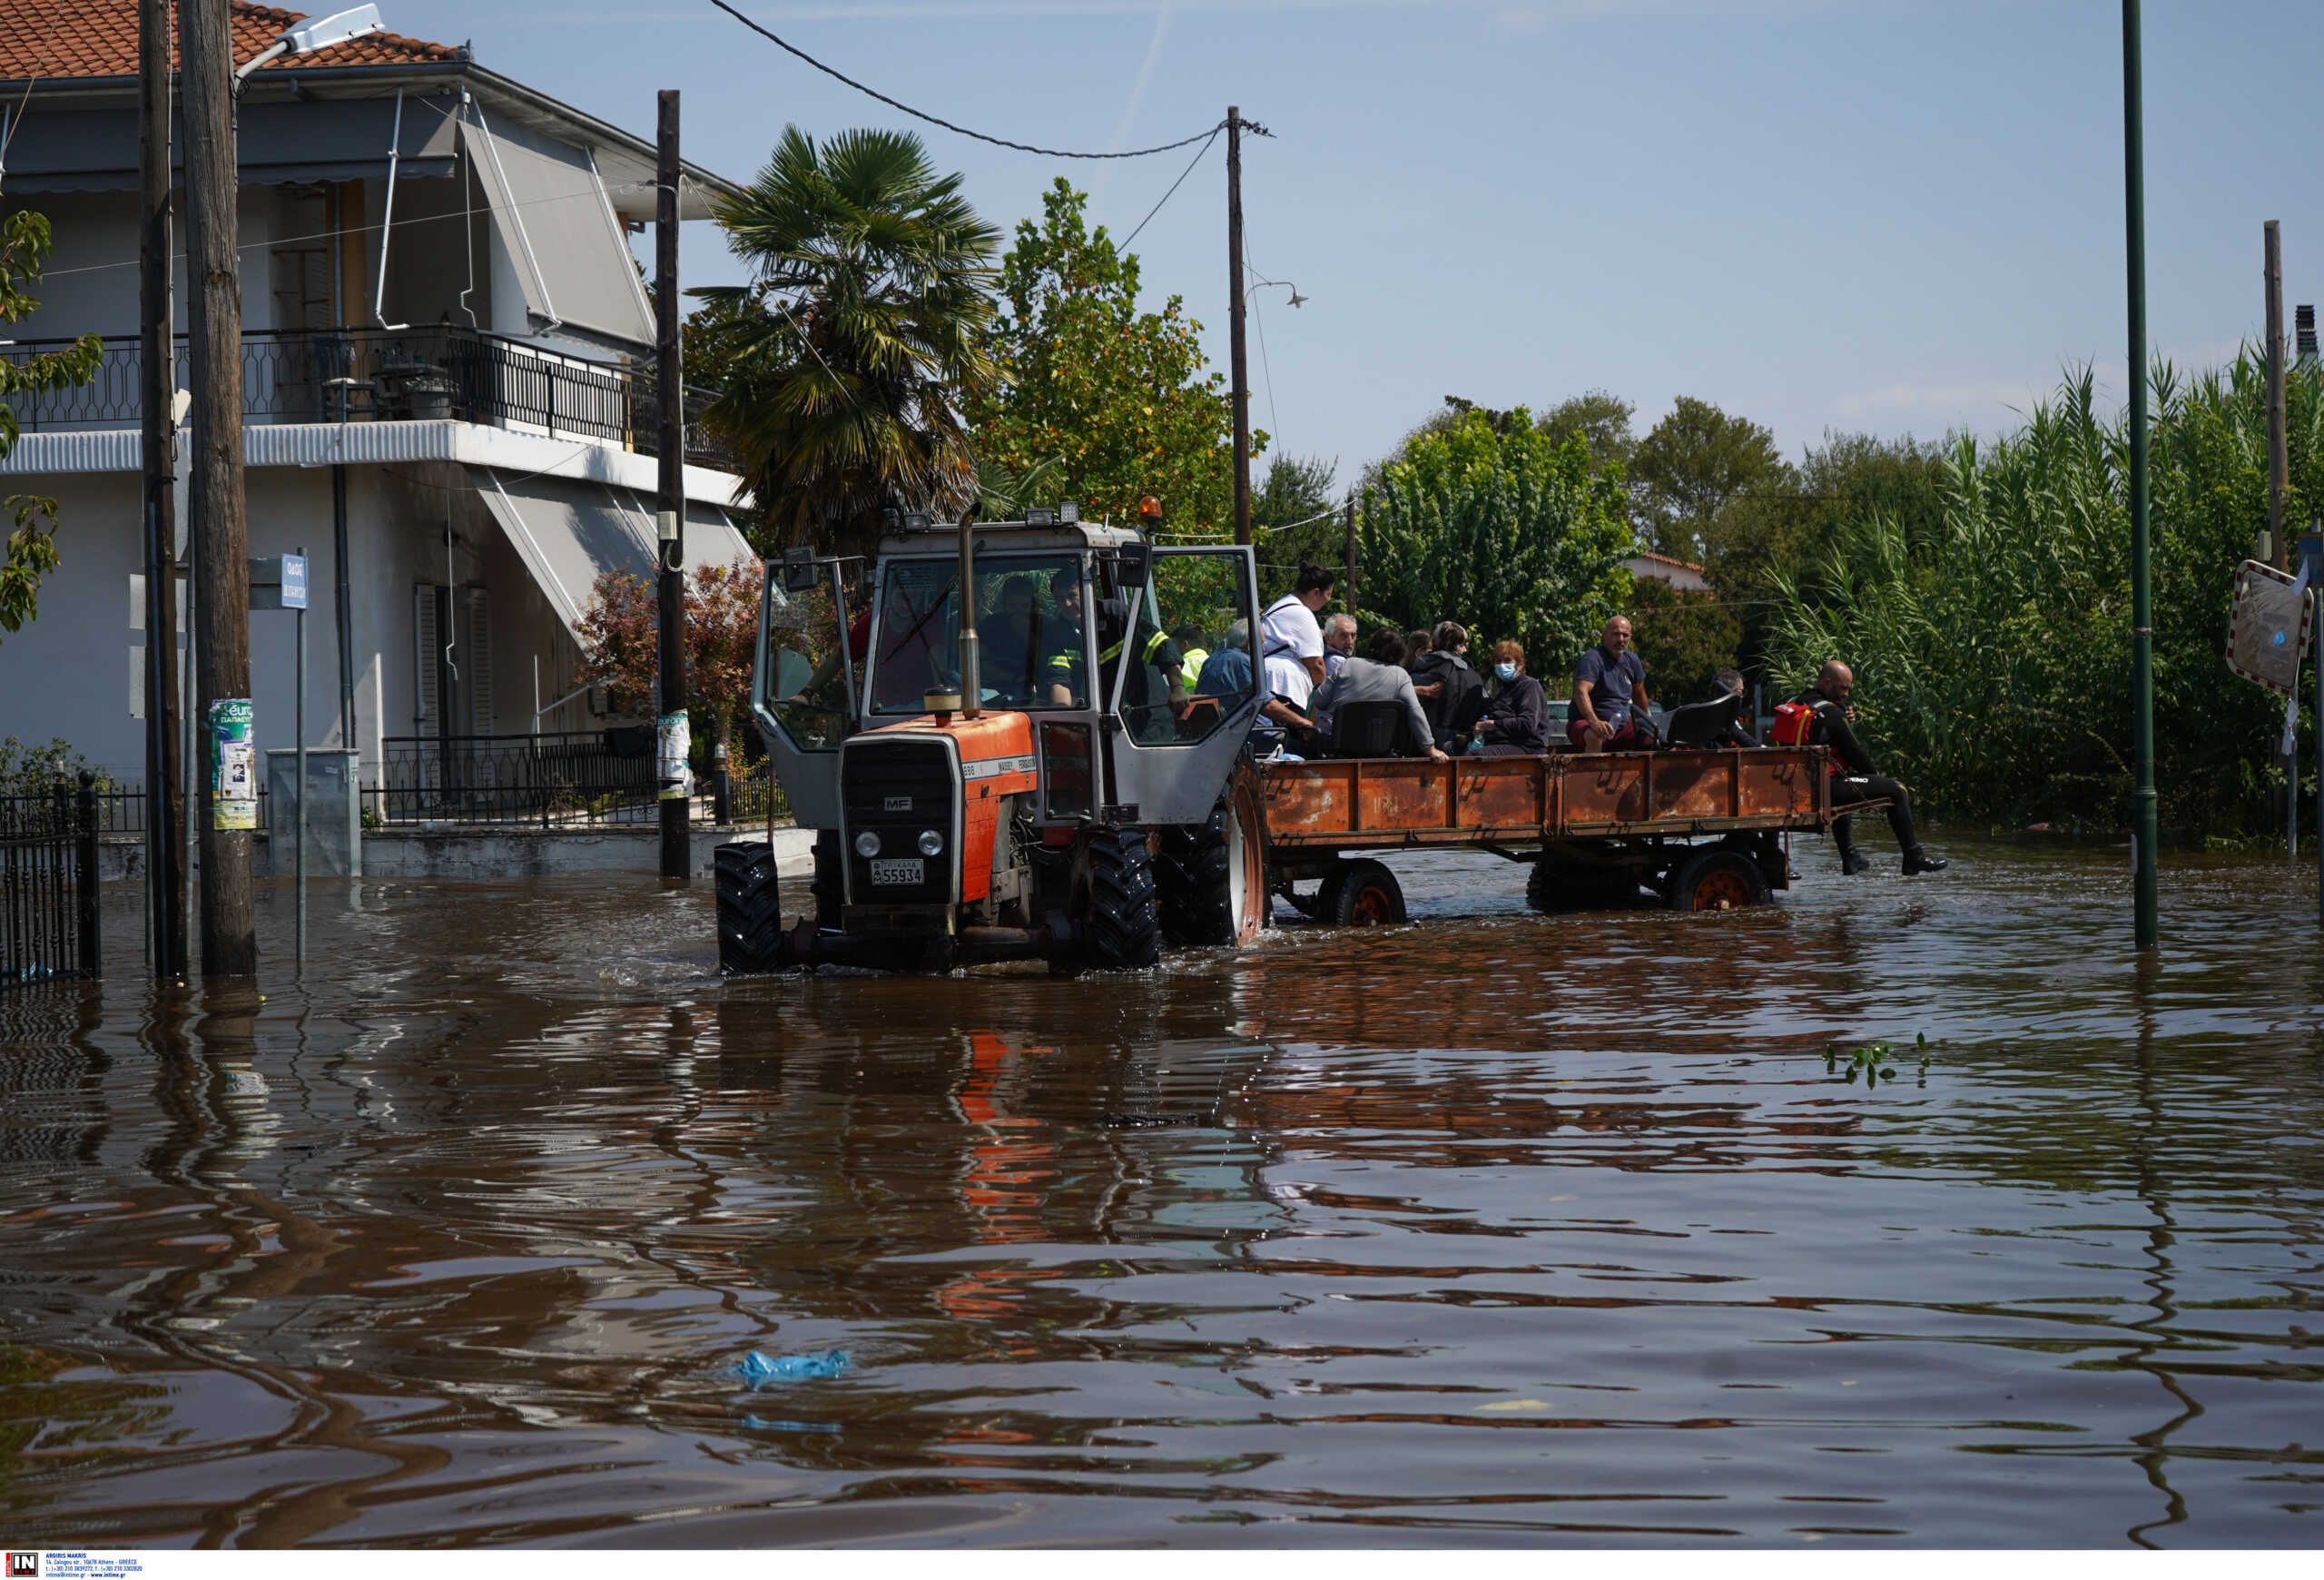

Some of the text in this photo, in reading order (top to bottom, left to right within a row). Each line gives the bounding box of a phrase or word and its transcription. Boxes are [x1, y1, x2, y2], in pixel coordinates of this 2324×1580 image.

[999, 762, 1013, 771] MASSEY
[886, 799, 910, 809] MF
[883, 869, 921, 883] 55934
